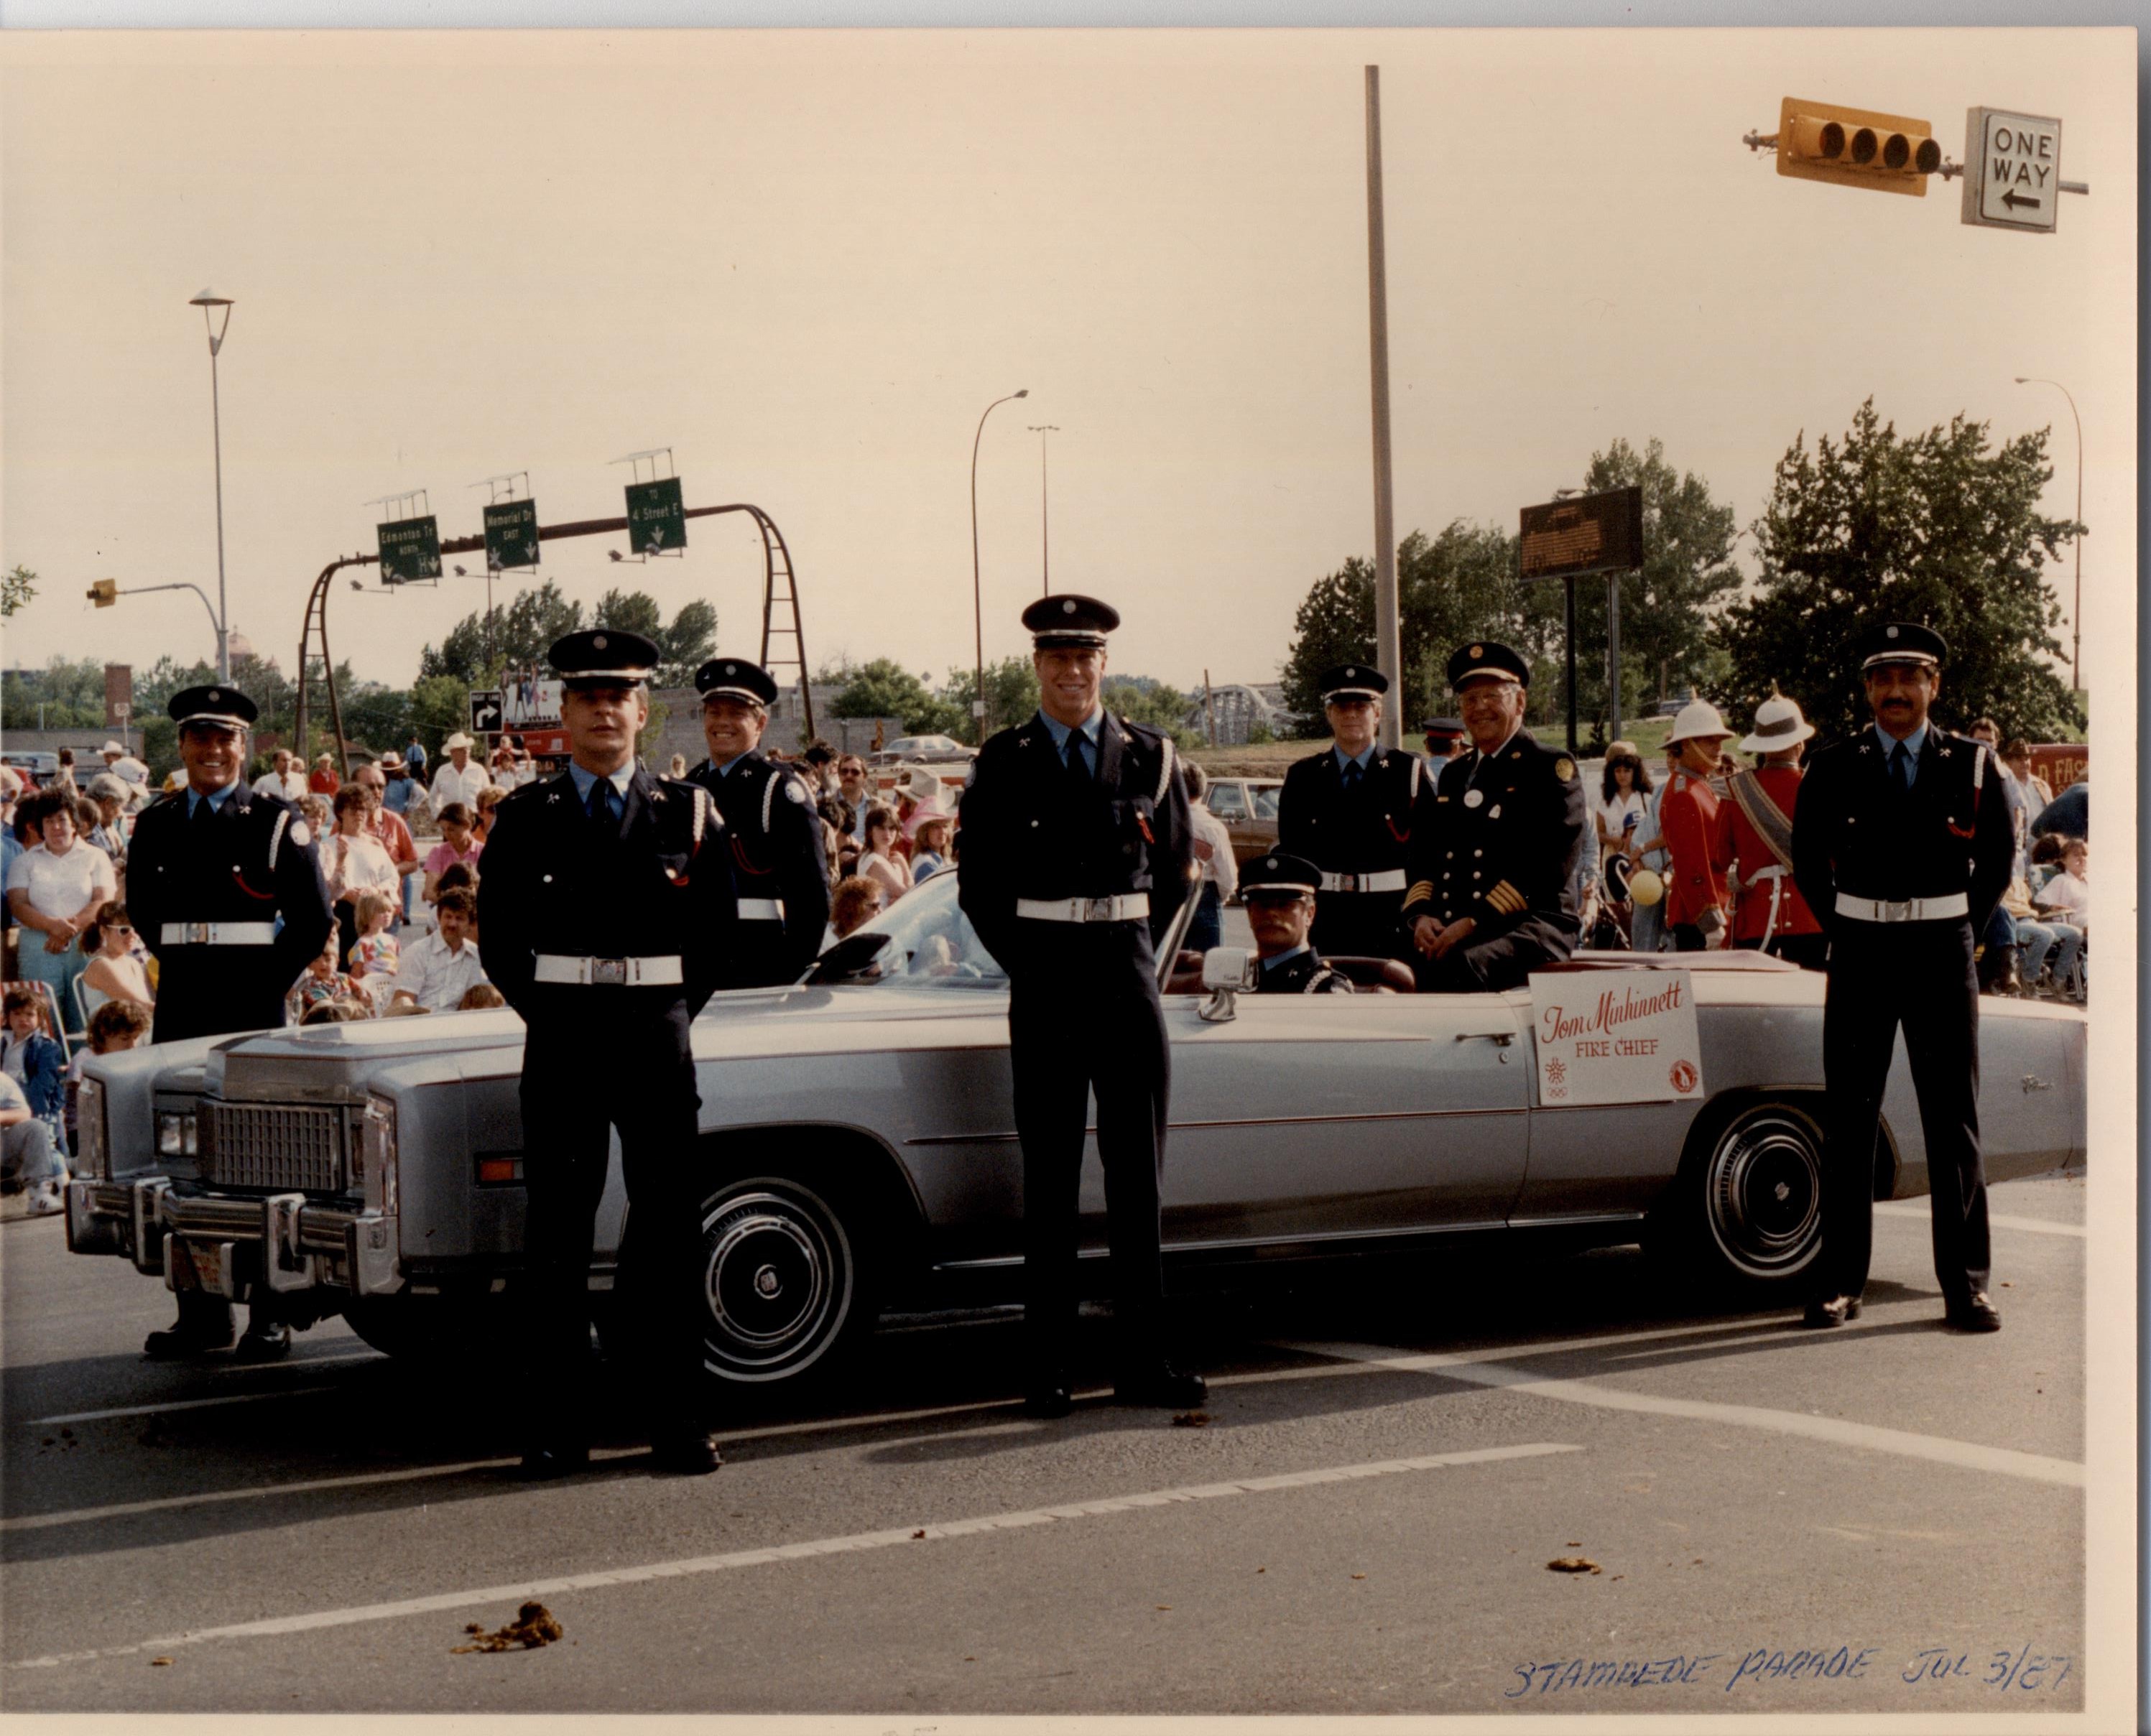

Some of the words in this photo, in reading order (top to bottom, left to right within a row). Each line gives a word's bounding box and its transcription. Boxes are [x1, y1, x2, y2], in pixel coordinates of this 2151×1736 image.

[1995, 128, 2052, 158] ONE
[1994, 158, 2050, 187] WAY
[487, 512, 521, 527] Memorial
[523, 509, 532, 521] Dr
[632, 509, 639, 521] 4
[643, 506, 670, 521] Street
[672, 503, 679, 516] E
[381, 530, 421, 544] Edmonton
[503, 529, 519, 540] EAST
[2055, 758, 2088, 784] FAS
[1541, 1006, 1584, 1044] Tom
[1587, 980, 1684, 1035] Minhinnett
[1576, 1041, 1610, 1057] FIRE
[1614, 1036, 1659, 1057] CHIEF
[1504, 1654, 1724, 1698] STAMPEDE
[1725, 1646, 1881, 1692] PARADE
[1902, 1648, 1971, 1684] JUL
[1983, 1643, 2073, 1691] 3/87
